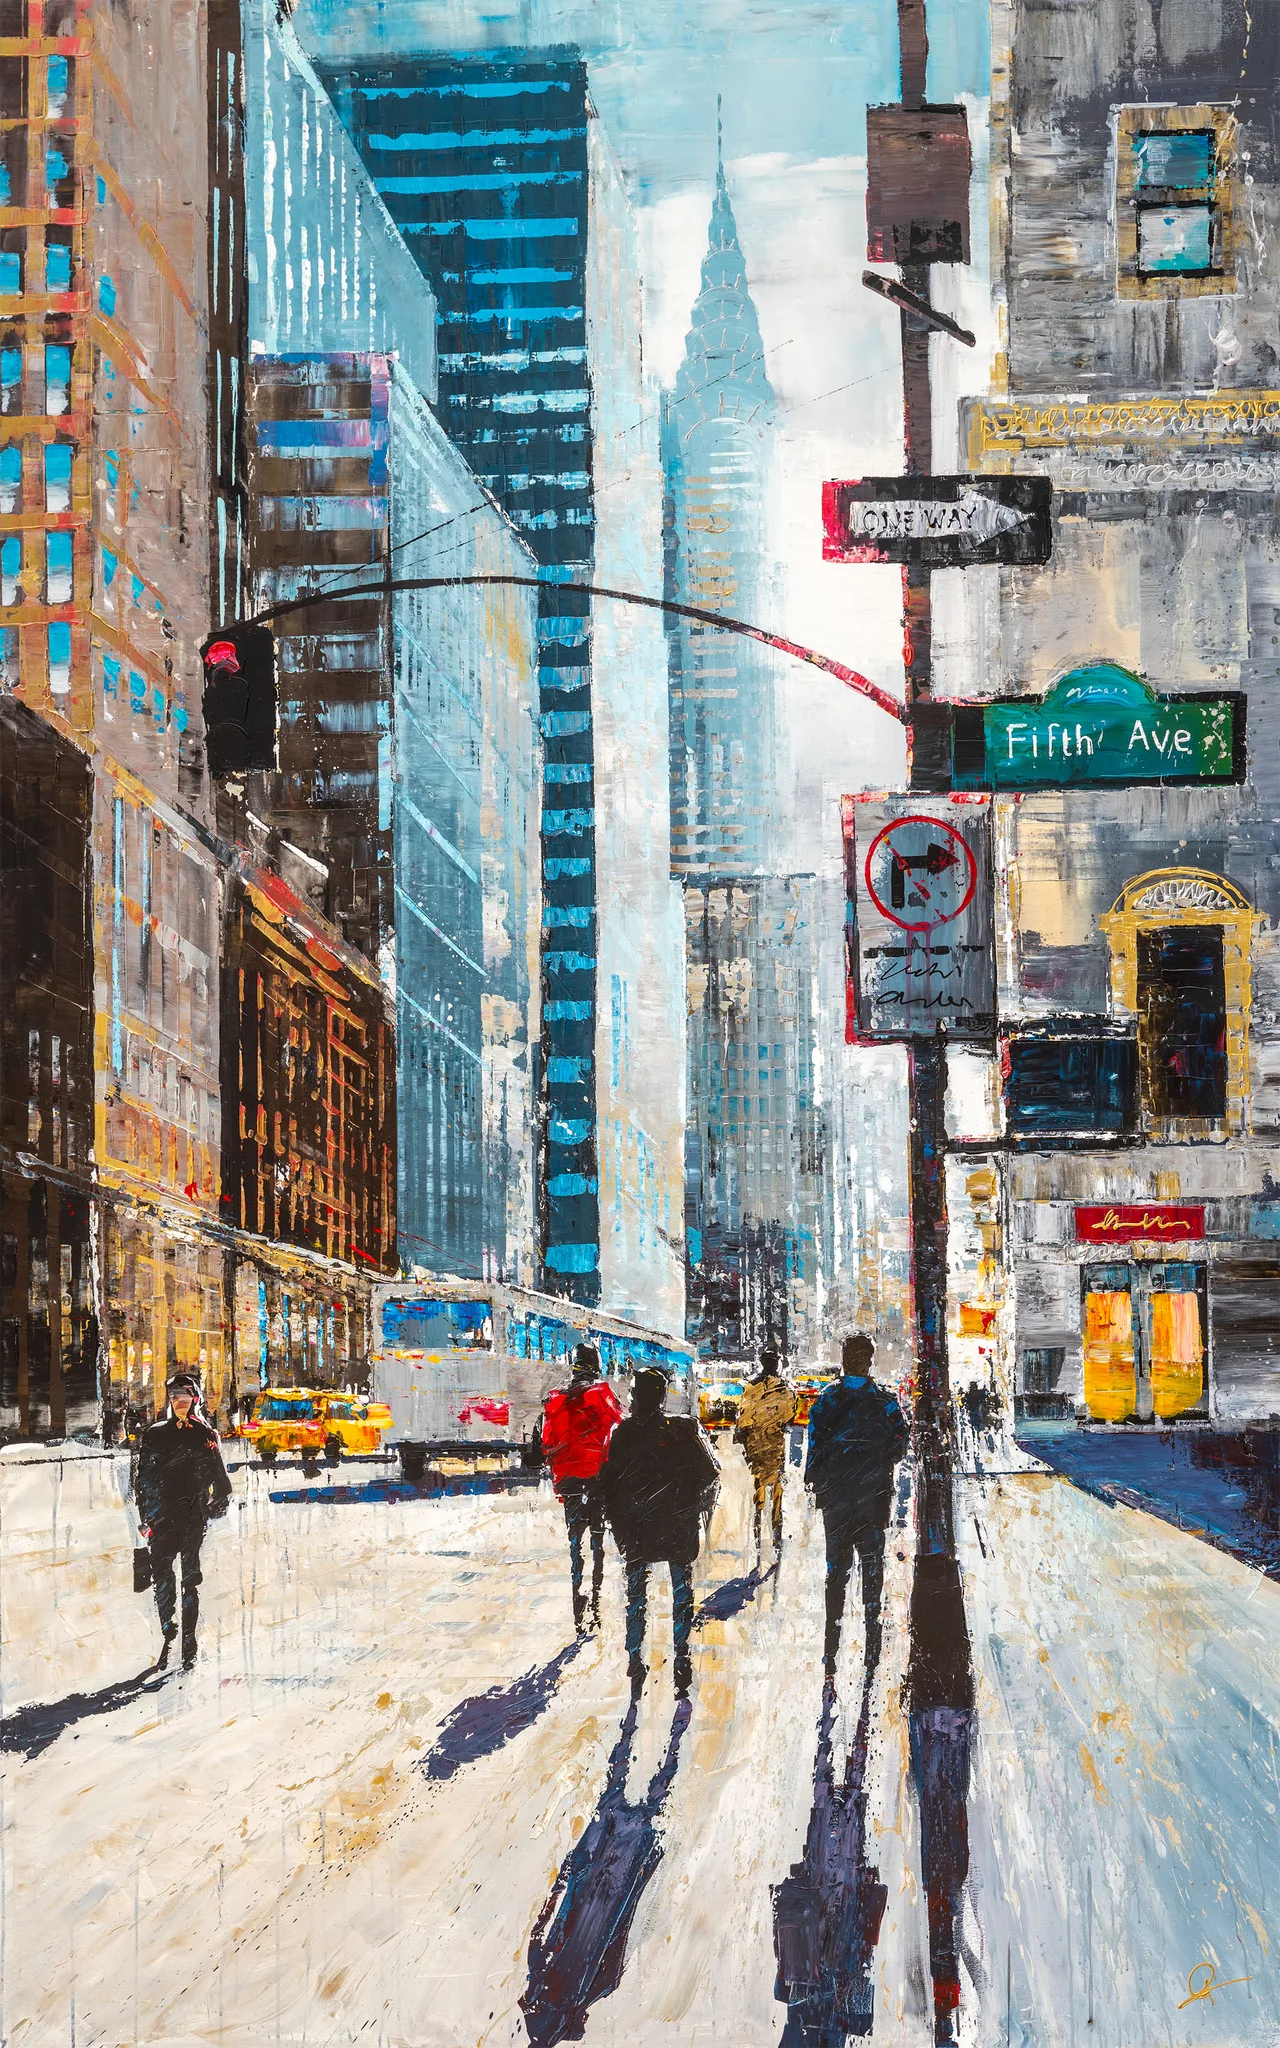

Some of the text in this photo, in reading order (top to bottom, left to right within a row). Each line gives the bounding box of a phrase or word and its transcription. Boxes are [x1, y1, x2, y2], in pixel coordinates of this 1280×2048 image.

[862, 506, 976, 532] ONE WAY
[1006, 719, 1192, 760] Fifth Ave
